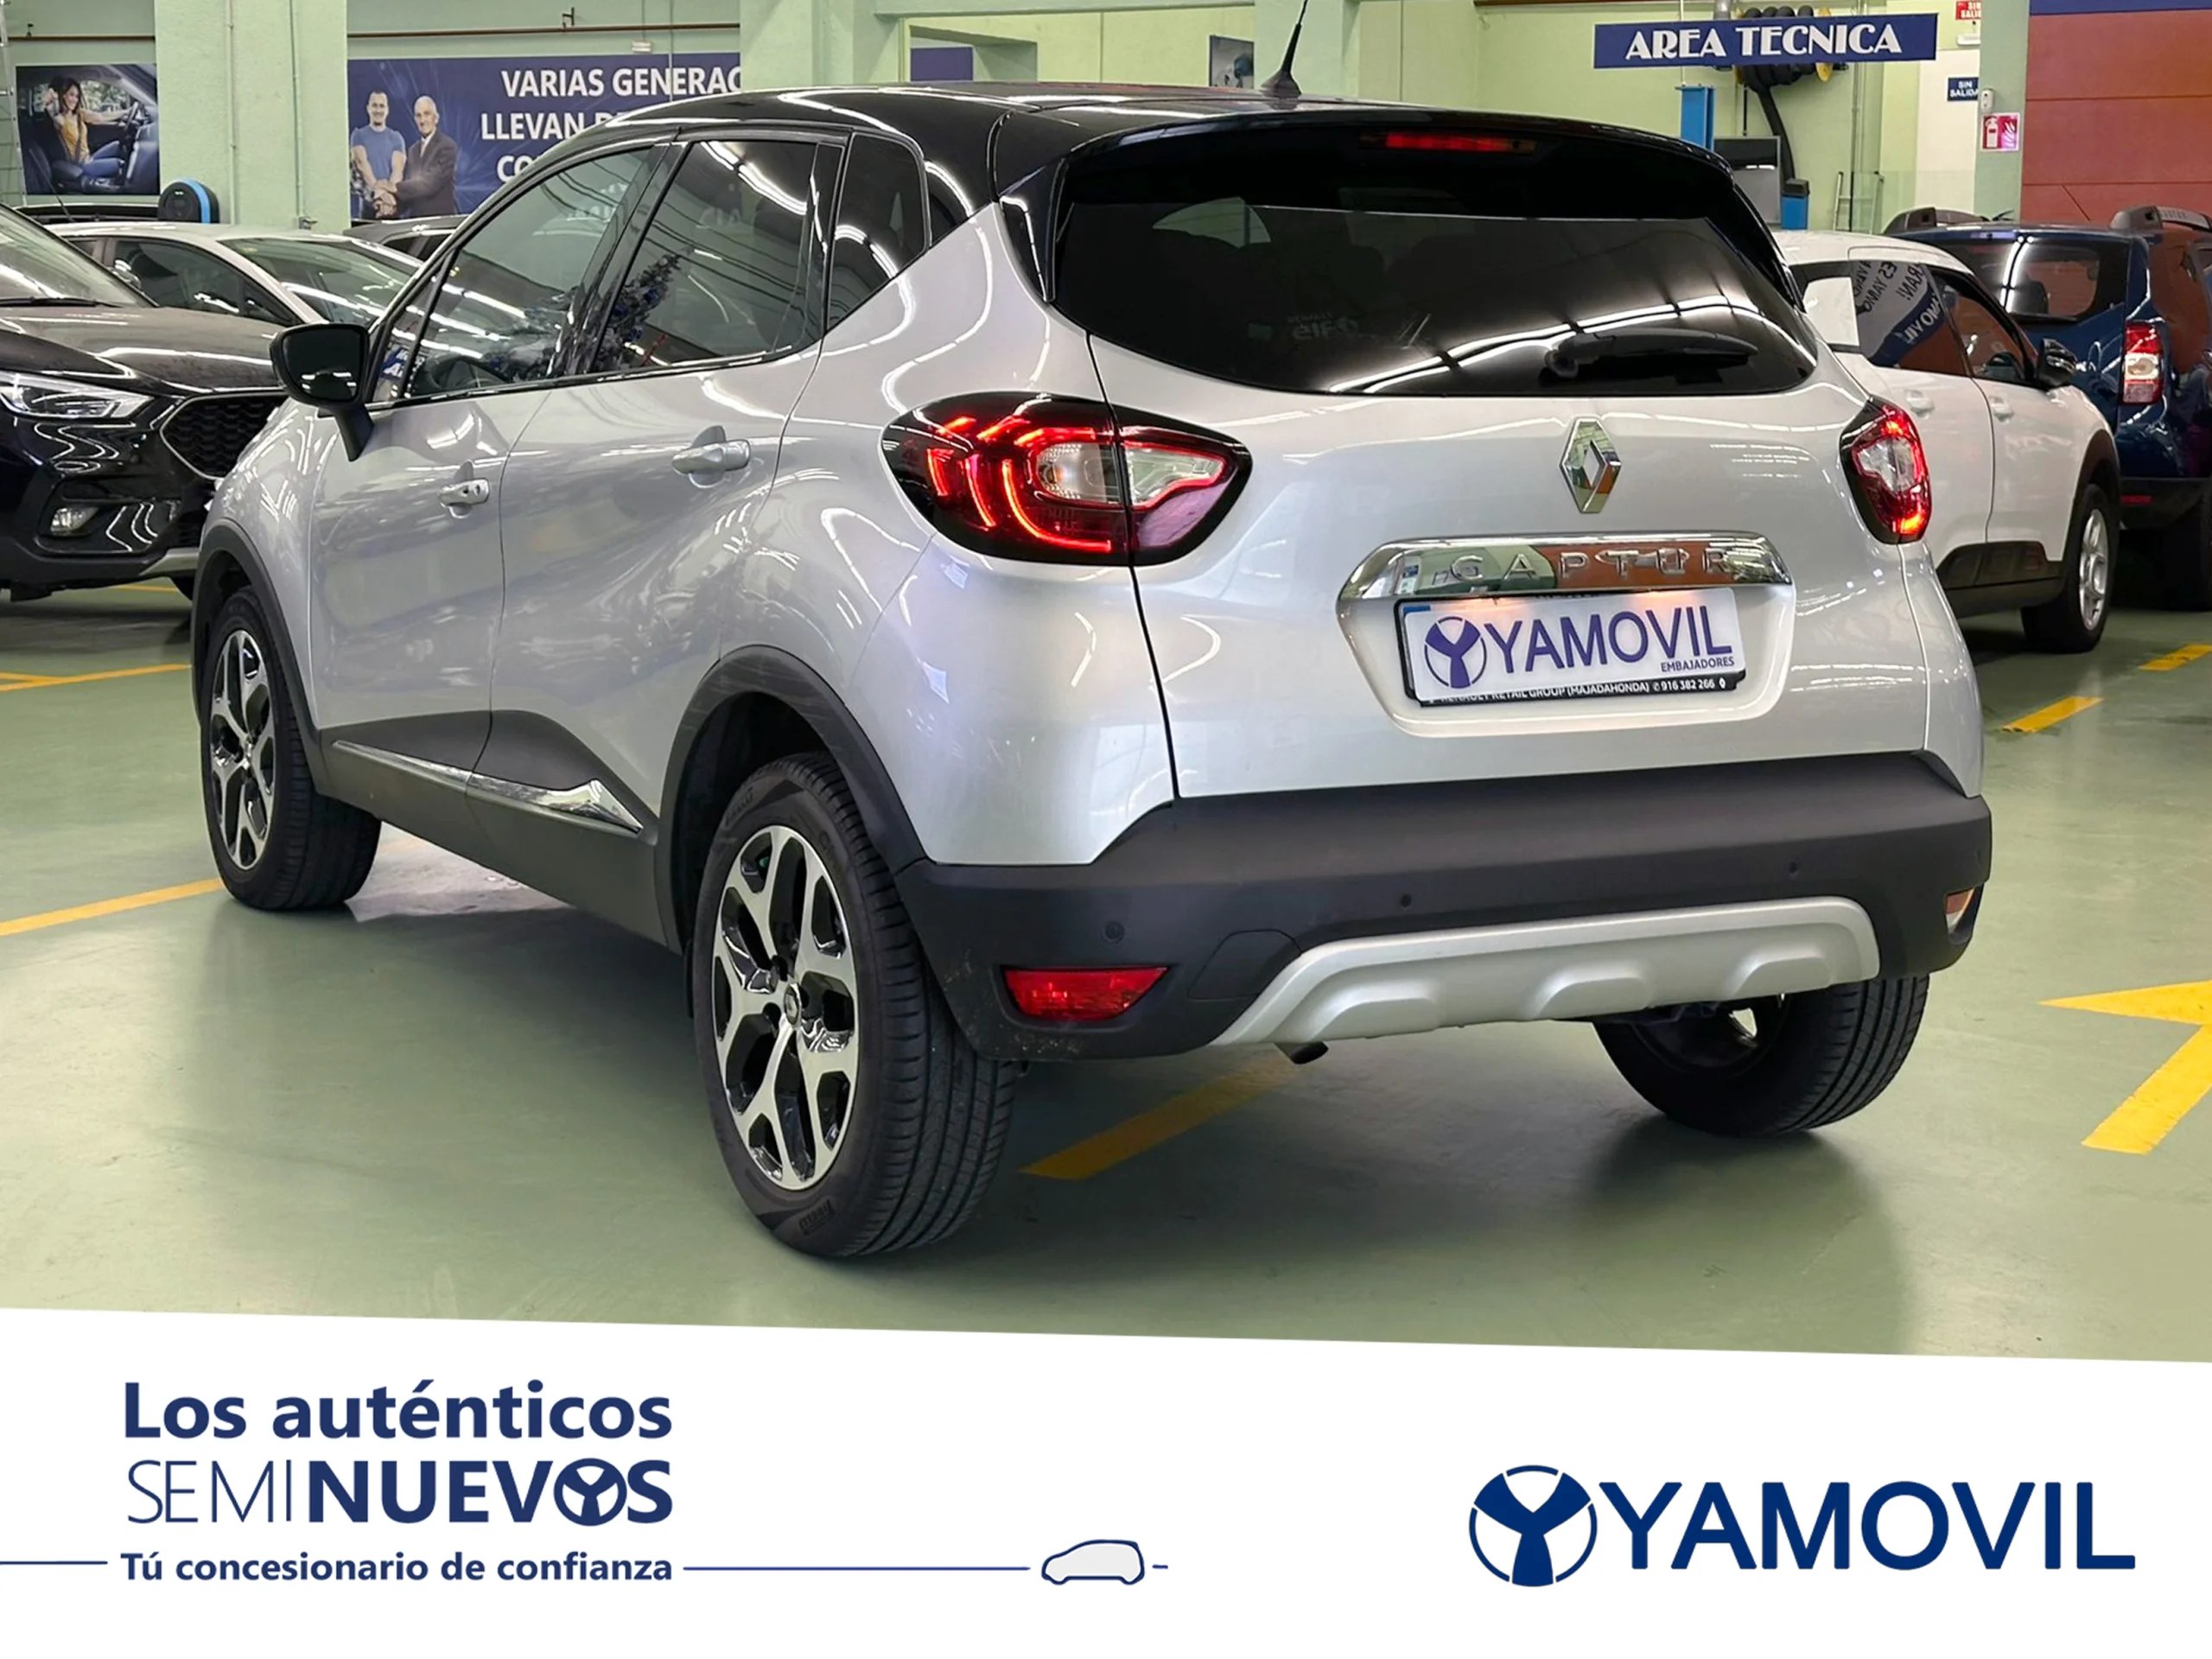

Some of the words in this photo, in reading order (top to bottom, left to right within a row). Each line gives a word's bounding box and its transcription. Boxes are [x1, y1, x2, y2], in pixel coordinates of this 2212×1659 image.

[1625, 29, 1727, 60] AREA
[1735, 22, 1903, 57] TECNICA
[500, 69, 605, 98] VARIAS
[481, 112, 585, 140] LLEVAN
[1452, 547, 1731, 582] CAPTUR
[1484, 606, 1732, 674] YAMOVIL
[1661, 657, 1735, 672] EMBAJADORES
[1529, 686, 1565, 697] GROUP
[1661, 680, 1679, 690] 916
